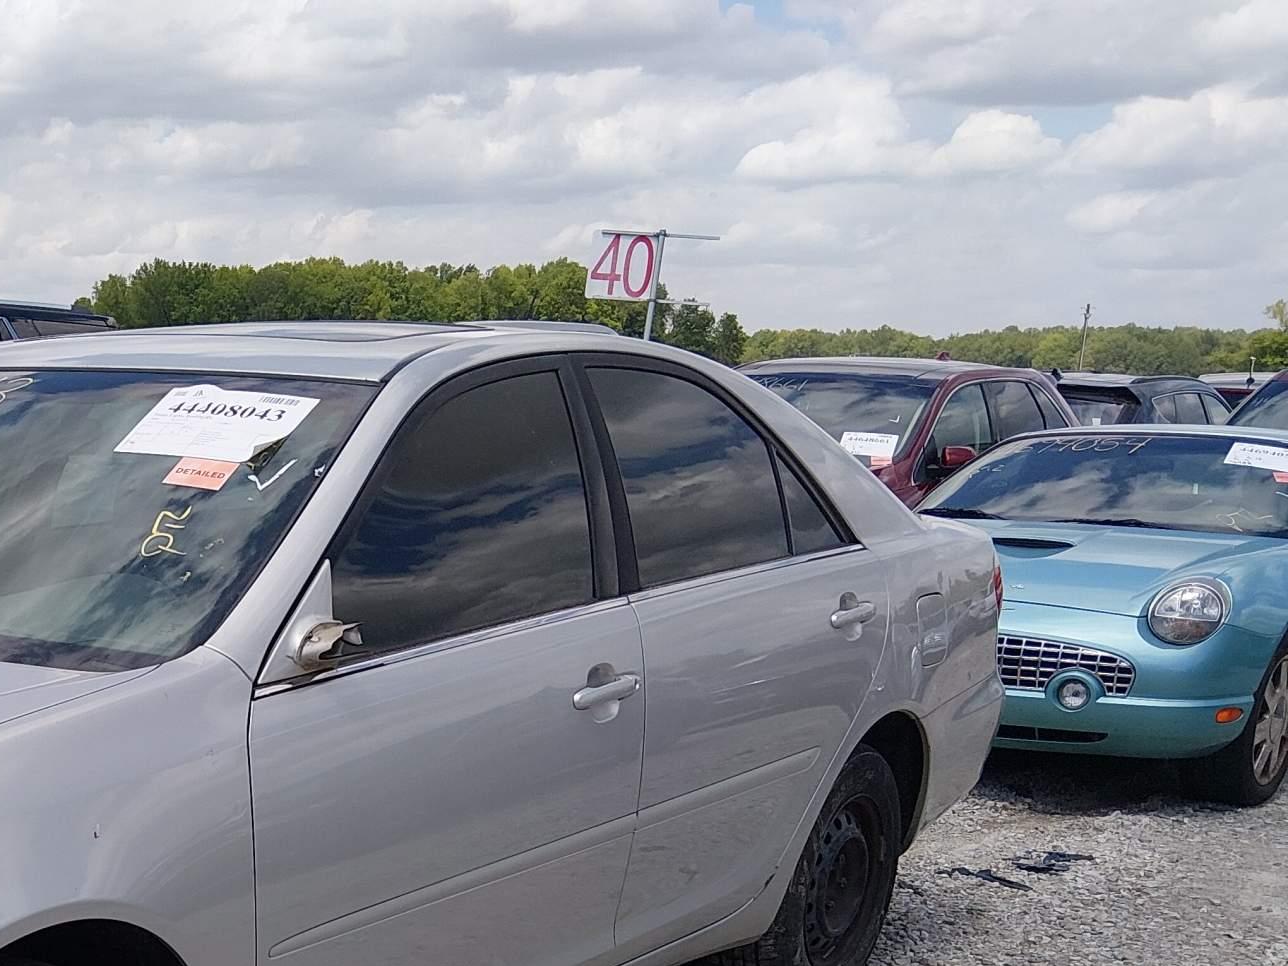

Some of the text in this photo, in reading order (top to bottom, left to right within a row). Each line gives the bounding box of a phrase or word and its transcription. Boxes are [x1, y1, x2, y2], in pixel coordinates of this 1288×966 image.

[590, 234, 654, 298] 40
[168, 401, 287, 422] 44408043
[175, 466, 226, 480] DETAILED
